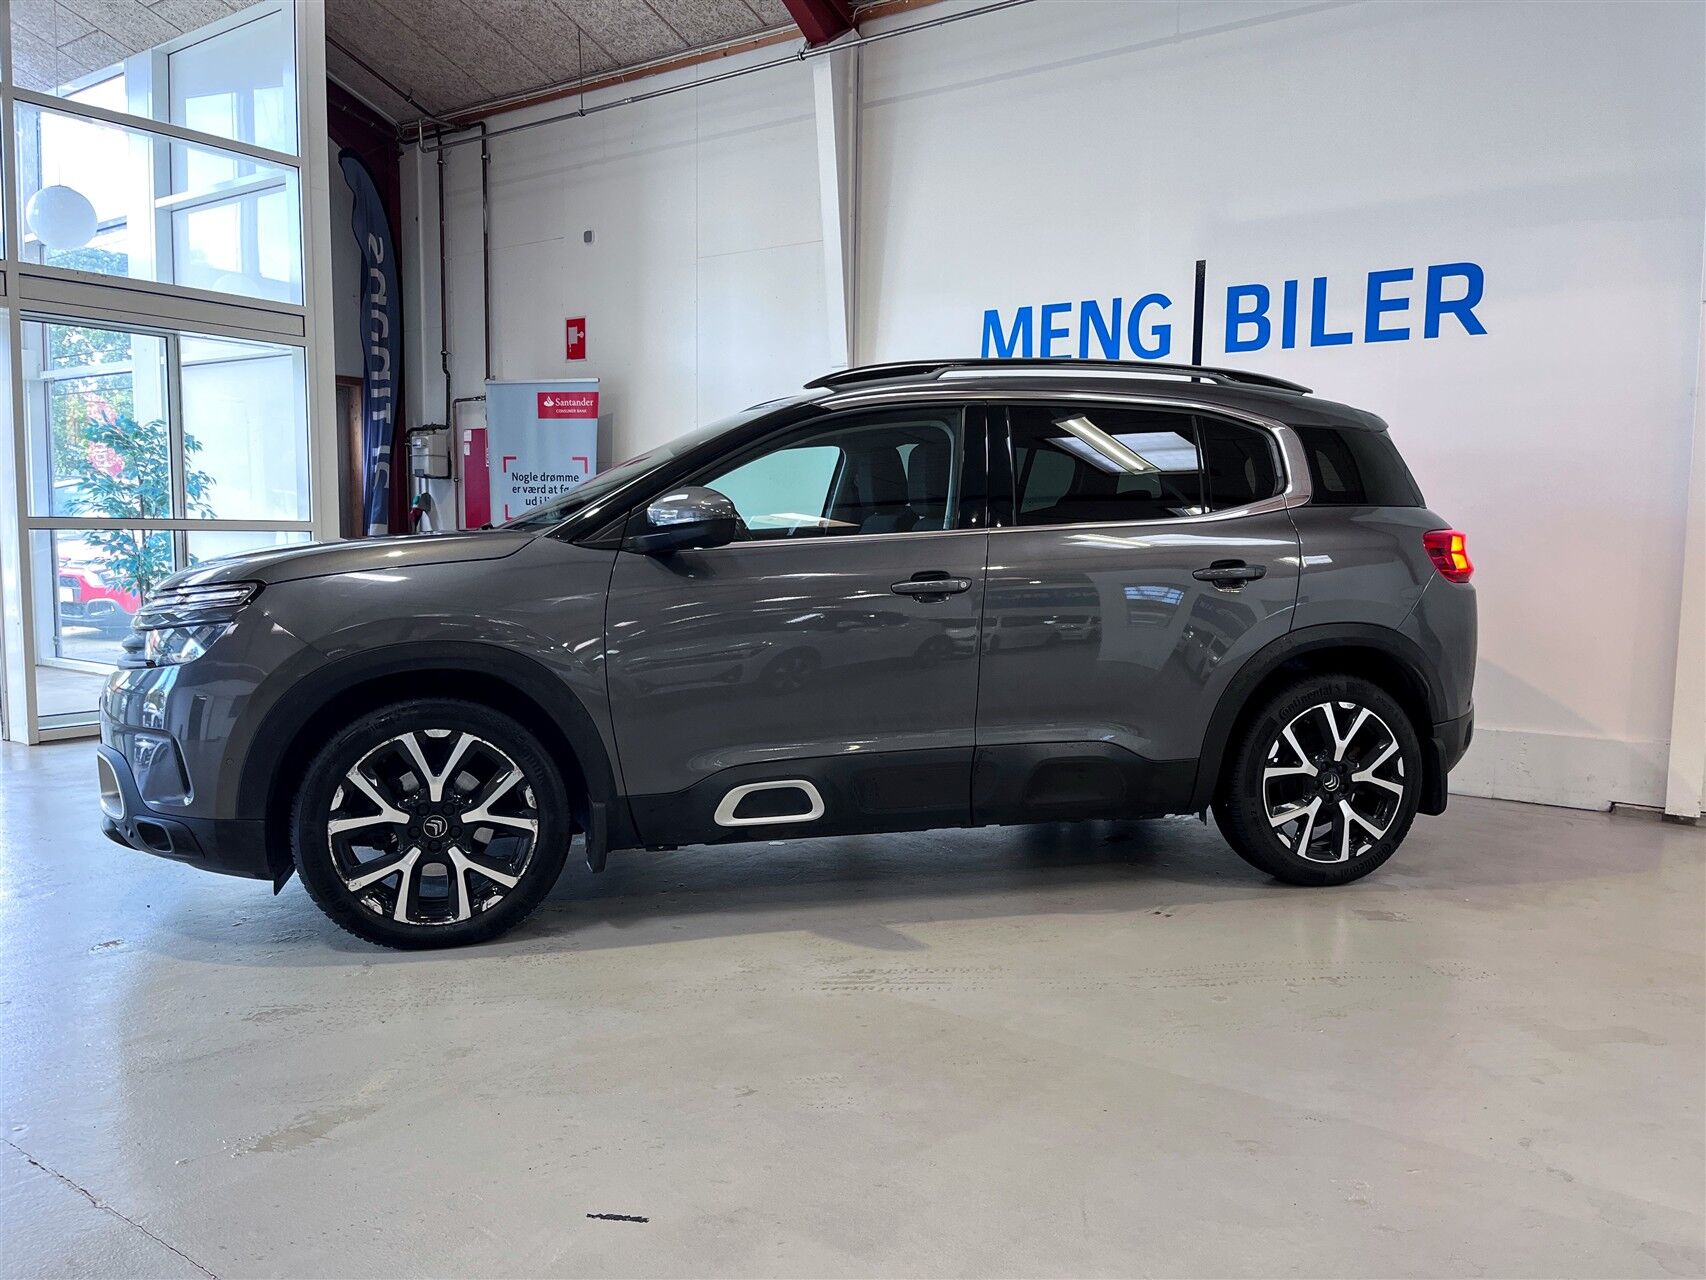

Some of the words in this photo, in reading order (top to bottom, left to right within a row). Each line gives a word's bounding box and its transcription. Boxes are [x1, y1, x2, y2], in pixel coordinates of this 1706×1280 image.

[981, 293, 1172, 360] MENG
[1224, 262, 1488, 353] BILER
[555, 396, 594, 407] Santander
[511, 472, 538, 484] Nogle
[540, 472, 579, 483] drømme
[522, 484, 546, 493] værd
[548, 485, 558, 494] at
[525, 496, 537, 505] ud
[1279, 683, 1333, 720] Continental
